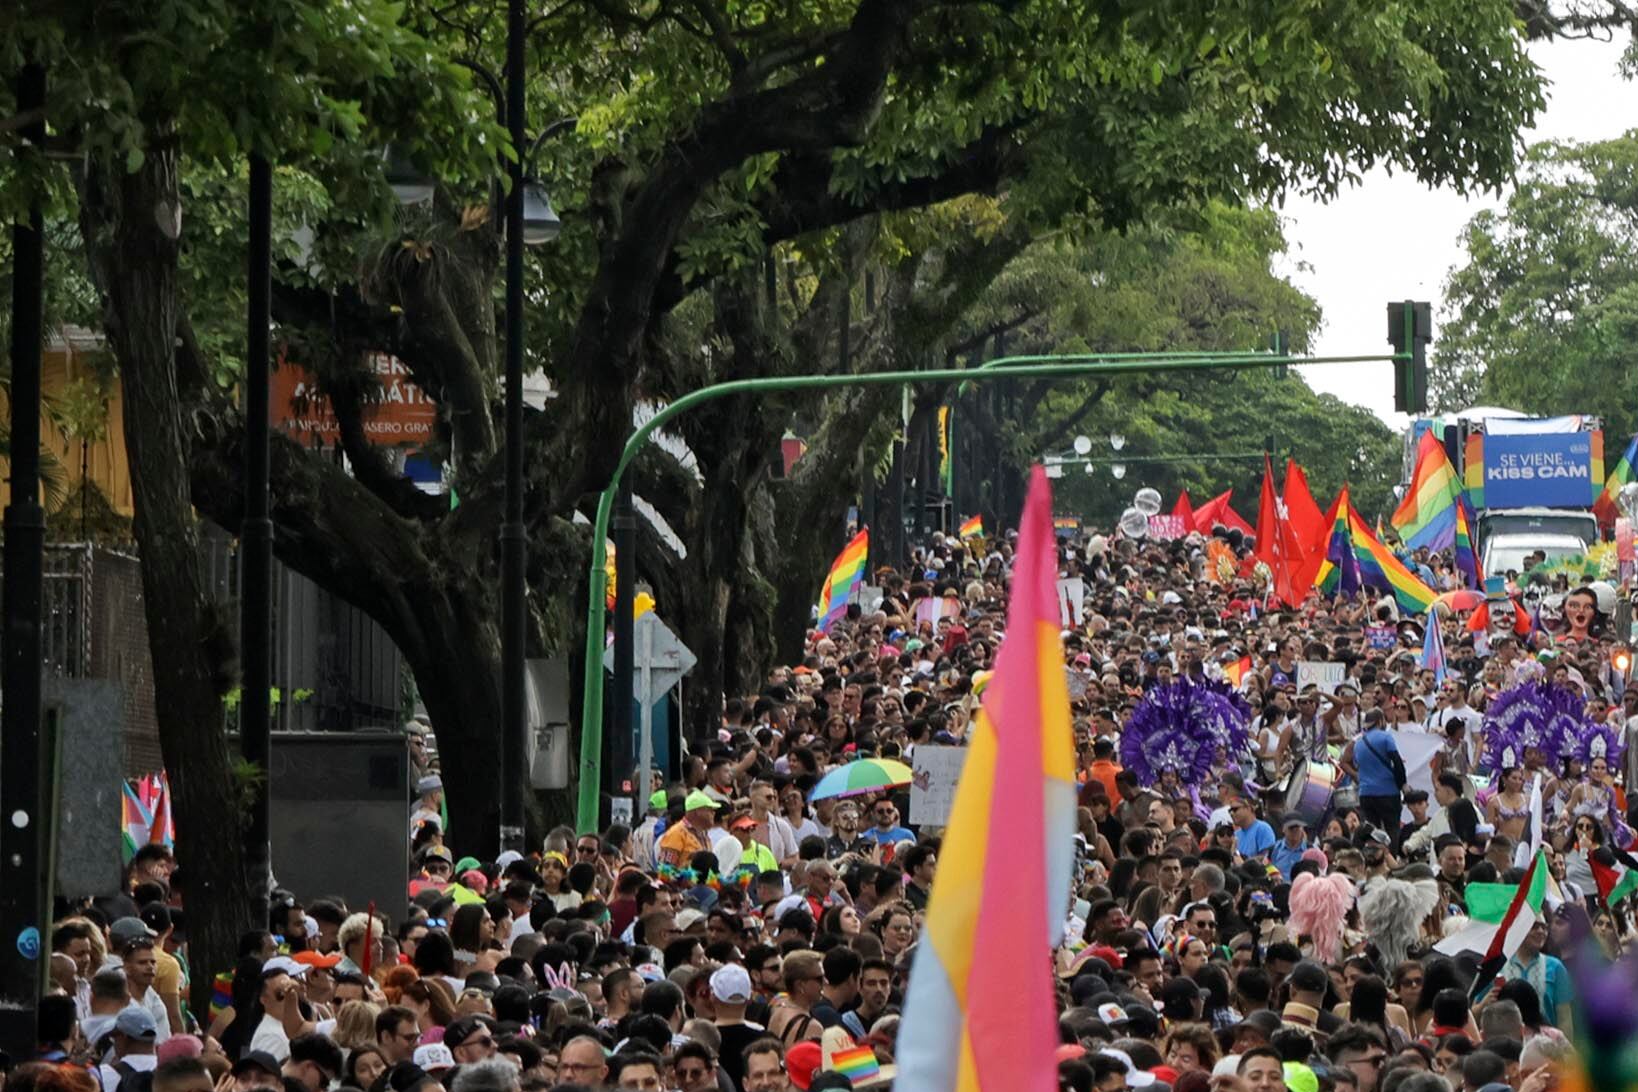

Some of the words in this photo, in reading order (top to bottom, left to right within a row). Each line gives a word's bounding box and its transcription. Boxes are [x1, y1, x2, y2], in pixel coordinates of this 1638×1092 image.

[1500, 454, 1517, 468] SE
[1488, 466, 1535, 480] KISS
[1538, 465, 1588, 478] CAM
